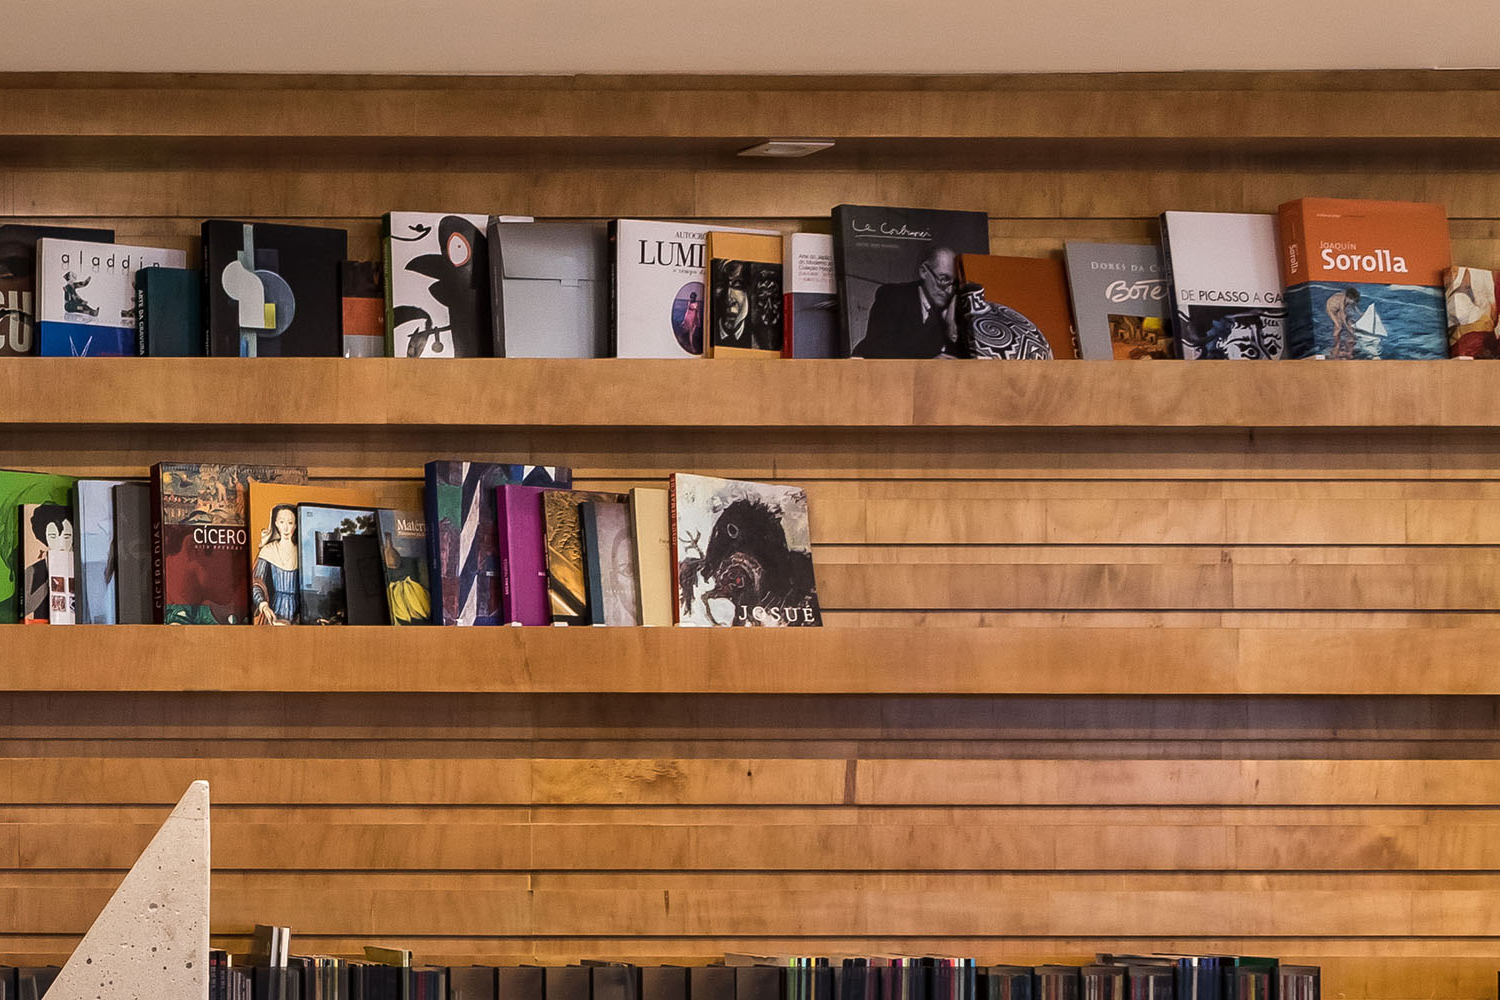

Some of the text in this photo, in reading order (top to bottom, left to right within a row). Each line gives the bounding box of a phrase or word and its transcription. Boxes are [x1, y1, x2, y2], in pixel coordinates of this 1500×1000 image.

[852, 219, 876, 233] Le
[1320, 241, 1357, 251] JOAQUÍN
[1091, 261, 1145, 273] DORES DA
[1289, 244, 1300, 274] Sorolla
[1321, 249, 1408, 273] Sorolla
[1181, 289, 1196, 301] DE
[1198, 290, 1249, 303] PICASSO
[1252, 292, 1262, 303] A
[193, 524, 247, 545] CÍCERO
[739, 596, 816, 623] JOSUÉ
